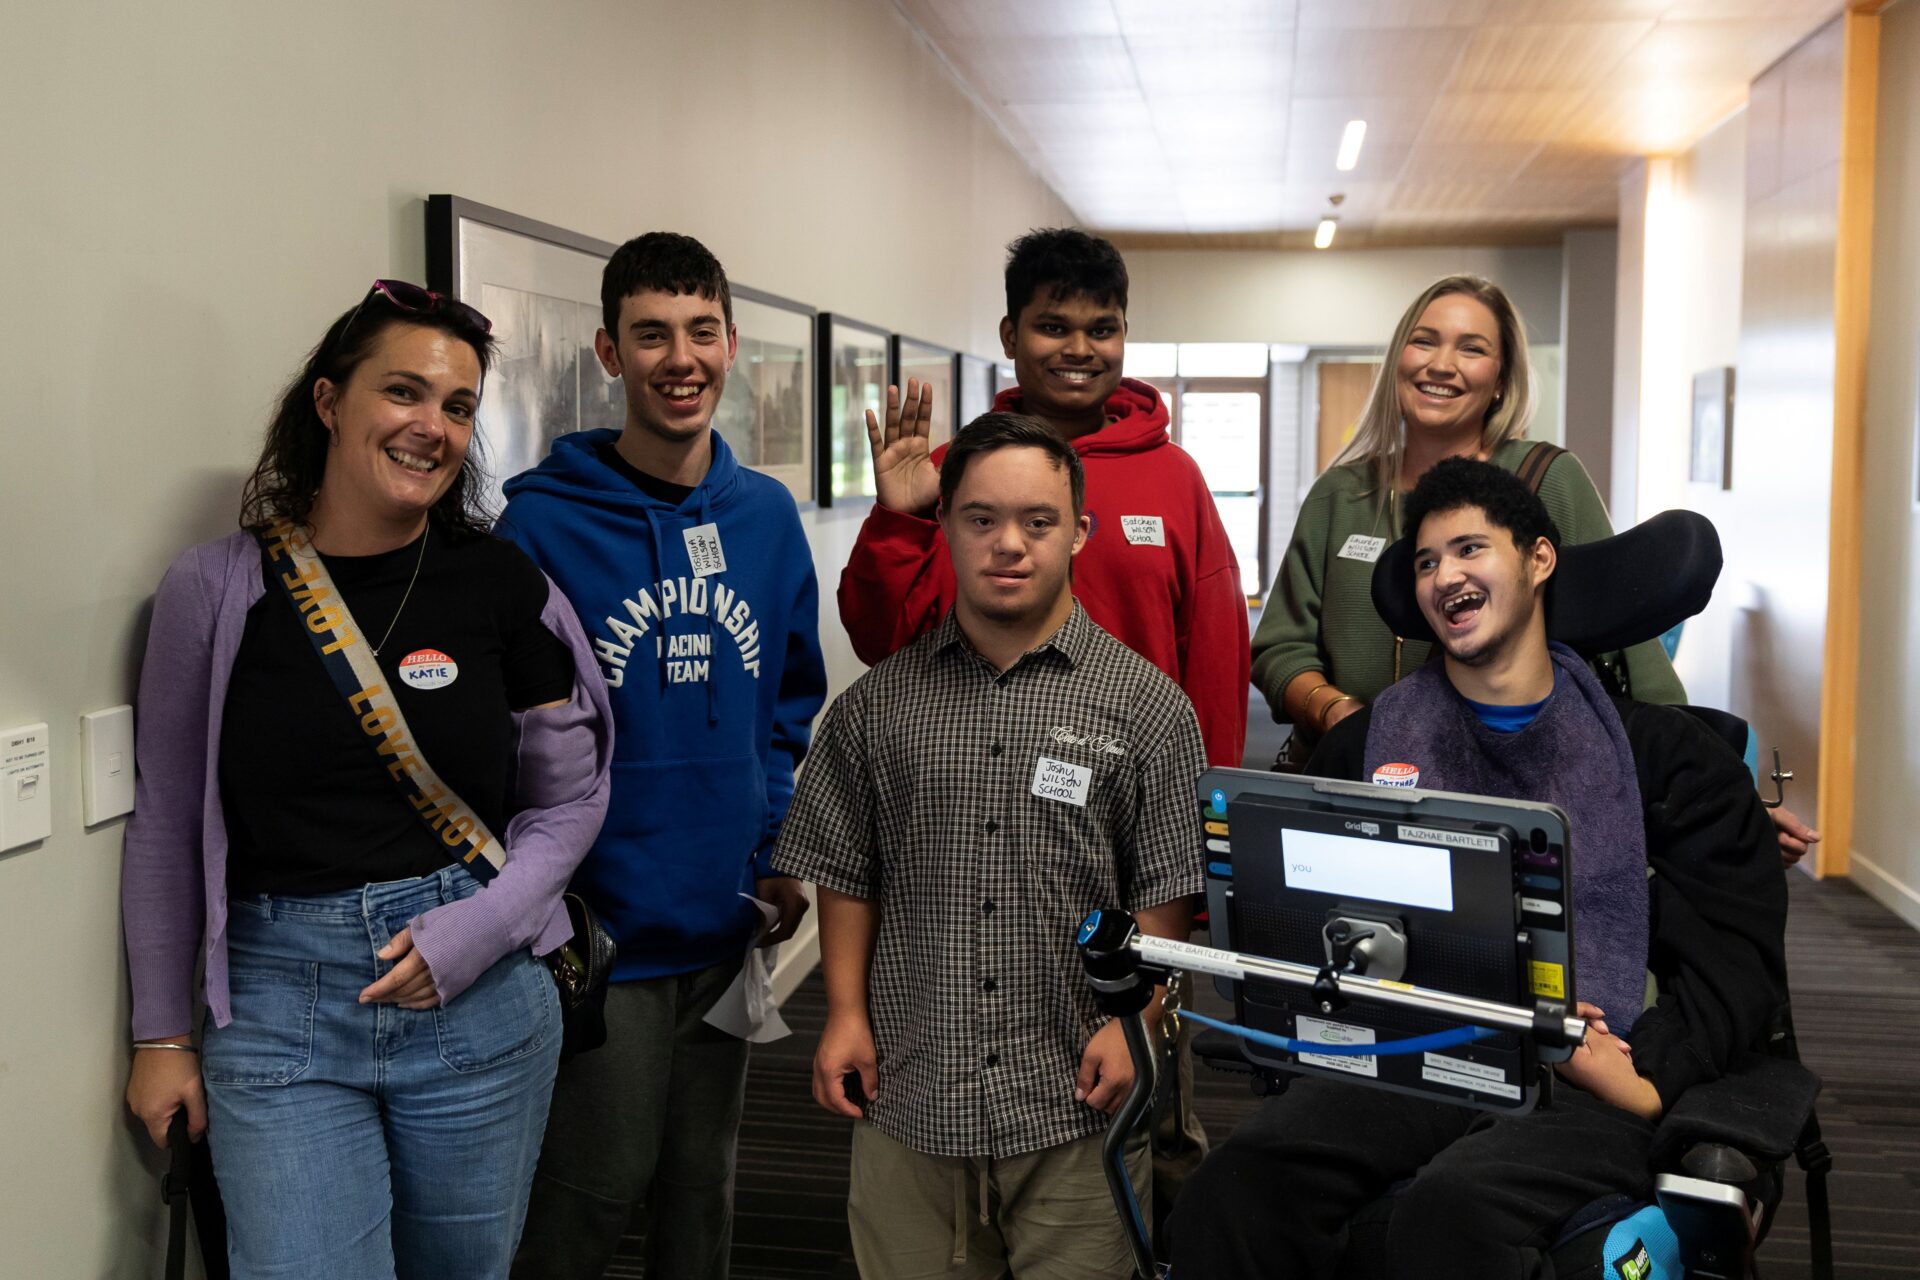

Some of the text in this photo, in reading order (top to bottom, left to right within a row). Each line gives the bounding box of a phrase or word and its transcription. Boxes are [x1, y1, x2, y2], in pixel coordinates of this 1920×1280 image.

[688, 538, 703, 573] JOSHUA
[697, 535, 711, 569] WILSON
[708, 537, 722, 569] SCHOOL
[282, 562, 356, 656] LOVE
[407, 653, 447, 664] HELLO
[408, 667, 448, 680] KATIE
[347, 684, 424, 782] LOVE
[1046, 761, 1075, 780] Joshy
[1381, 766, 1415, 775] HELLO
[1042, 774, 1082, 787] WILSON
[1038, 784, 1076, 799] SCHOOL
[408, 782, 491, 864] LOVE
[1345, 822, 1361, 830] Grid
[1401, 829, 1495, 848] TAJZHAE BARTLETT
[1291, 863, 1312, 874] you
[1145, 938, 1232, 961] TAJZHAE BARTLETT
